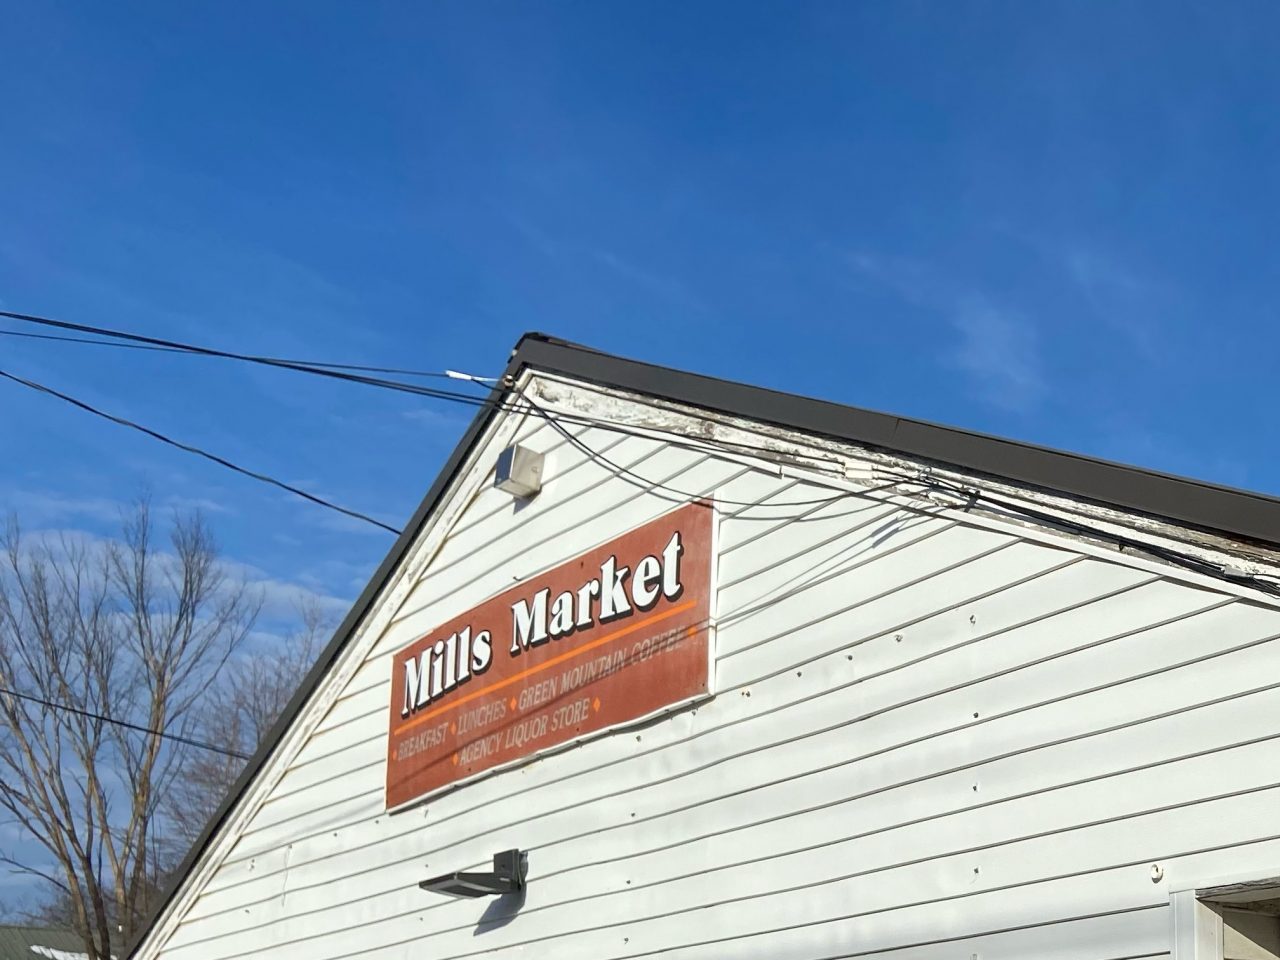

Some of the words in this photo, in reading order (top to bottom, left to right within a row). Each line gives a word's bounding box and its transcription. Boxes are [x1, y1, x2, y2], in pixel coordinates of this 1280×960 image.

[401, 626, 491, 718] Mills
[511, 531, 683, 655] Market
[399, 723, 449, 761] BREAKFAST
[458, 699, 507, 736] LUNCHES
[519, 677, 558, 710] GREEN
[560, 648, 627, 694] MOUNTAIN
[631, 626, 686, 666] COFFEE
[460, 732, 503, 766] AGENCY
[506, 715, 549, 749] LIQUOR
[552, 698, 591, 730] STORE
